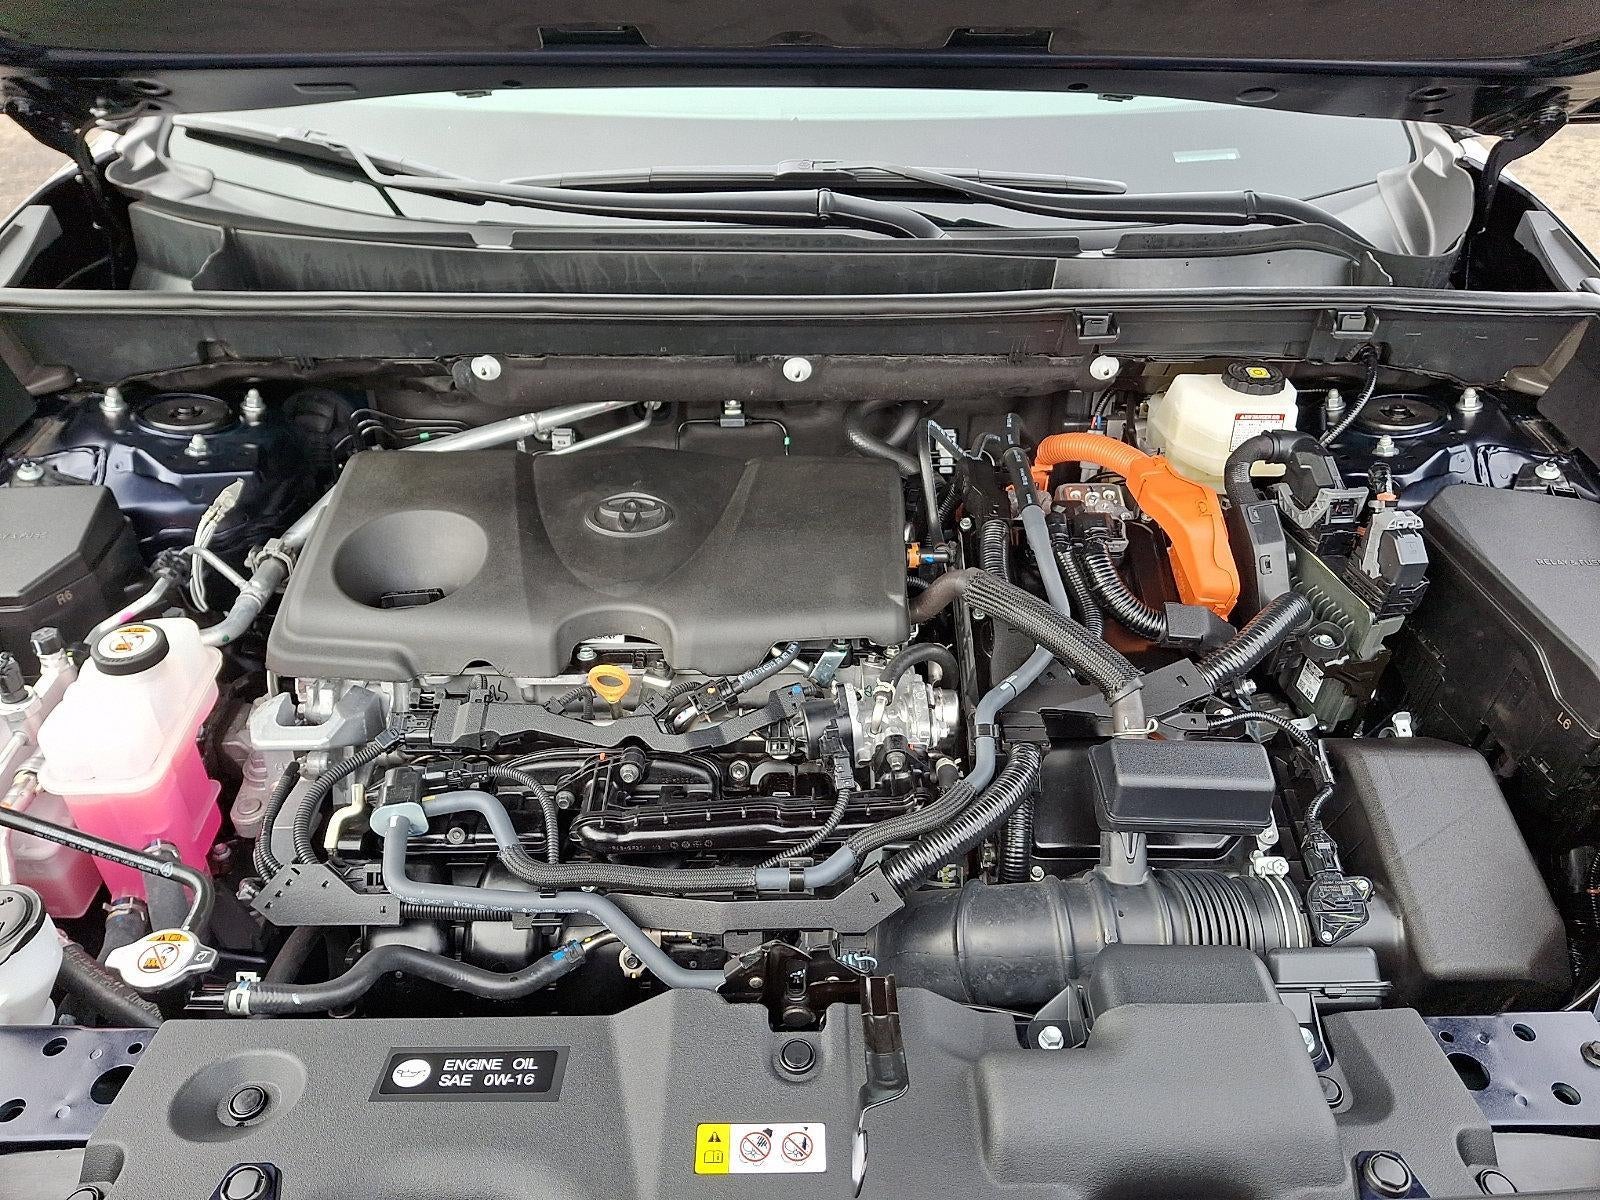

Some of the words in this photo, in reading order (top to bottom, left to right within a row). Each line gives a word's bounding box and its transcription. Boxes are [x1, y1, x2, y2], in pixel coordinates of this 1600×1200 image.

[1556, 711, 1572, 730] L6
[442, 1058, 504, 1071] ENGINE
[512, 1057, 539, 1070] OIL
[438, 1074, 474, 1087] SAE
[483, 1073, 536, 1086] 0W-16
